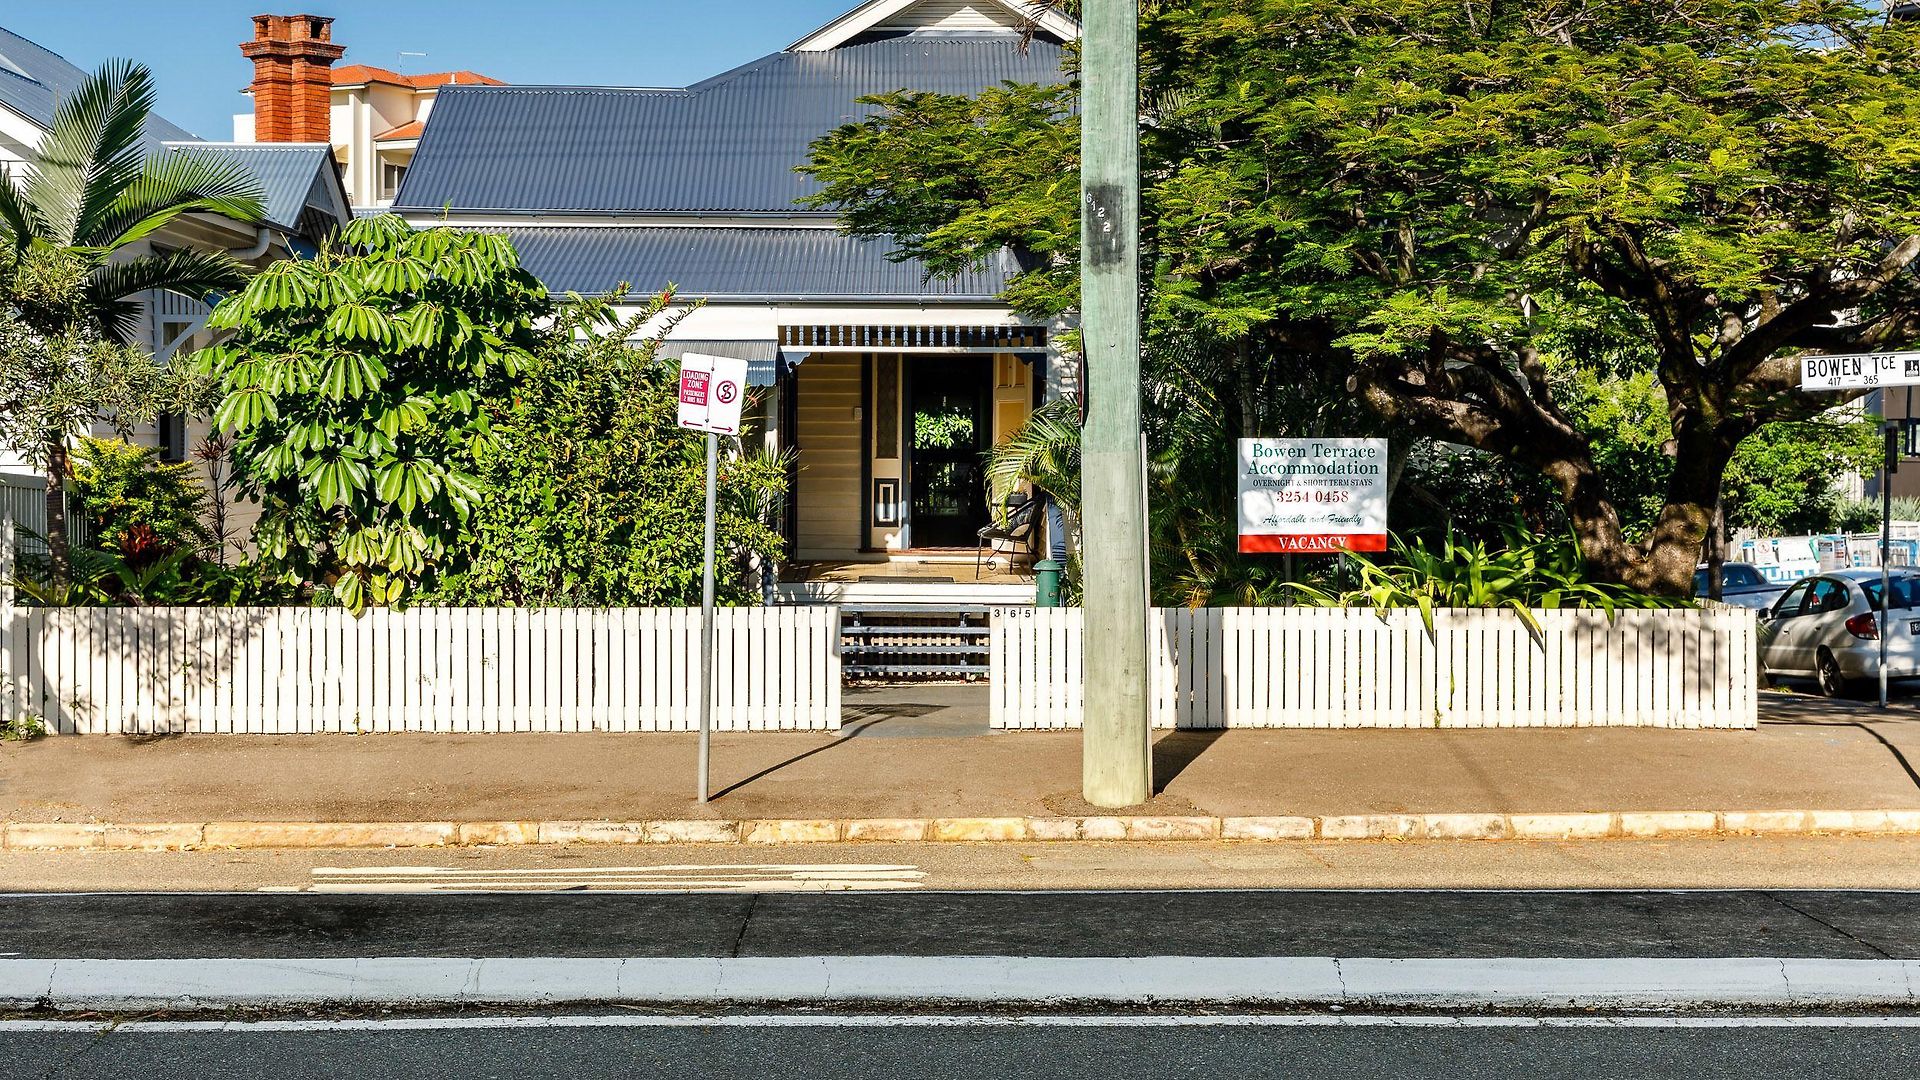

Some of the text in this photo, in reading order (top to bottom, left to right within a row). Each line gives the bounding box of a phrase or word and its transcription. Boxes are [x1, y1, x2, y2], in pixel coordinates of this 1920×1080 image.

[1807, 355, 1896, 378] BOWEN TCE
[683, 371, 708, 381] LOADING
[1828, 376, 1841, 386] 417
[1863, 375, 1878, 385] 365
[687, 380, 704, 389] ZONE
[1252, 443, 1376, 458] Bowen Terrace
[1247, 460, 1379, 475] Accommodation
[1252, 479, 1294, 487] OVERNIGHT
[1277, 490, 1349, 503] 3254 0458
[1262, 513, 1362, 526] Affordable and Friendly
[1278, 536, 1346, 550] VACANCY
